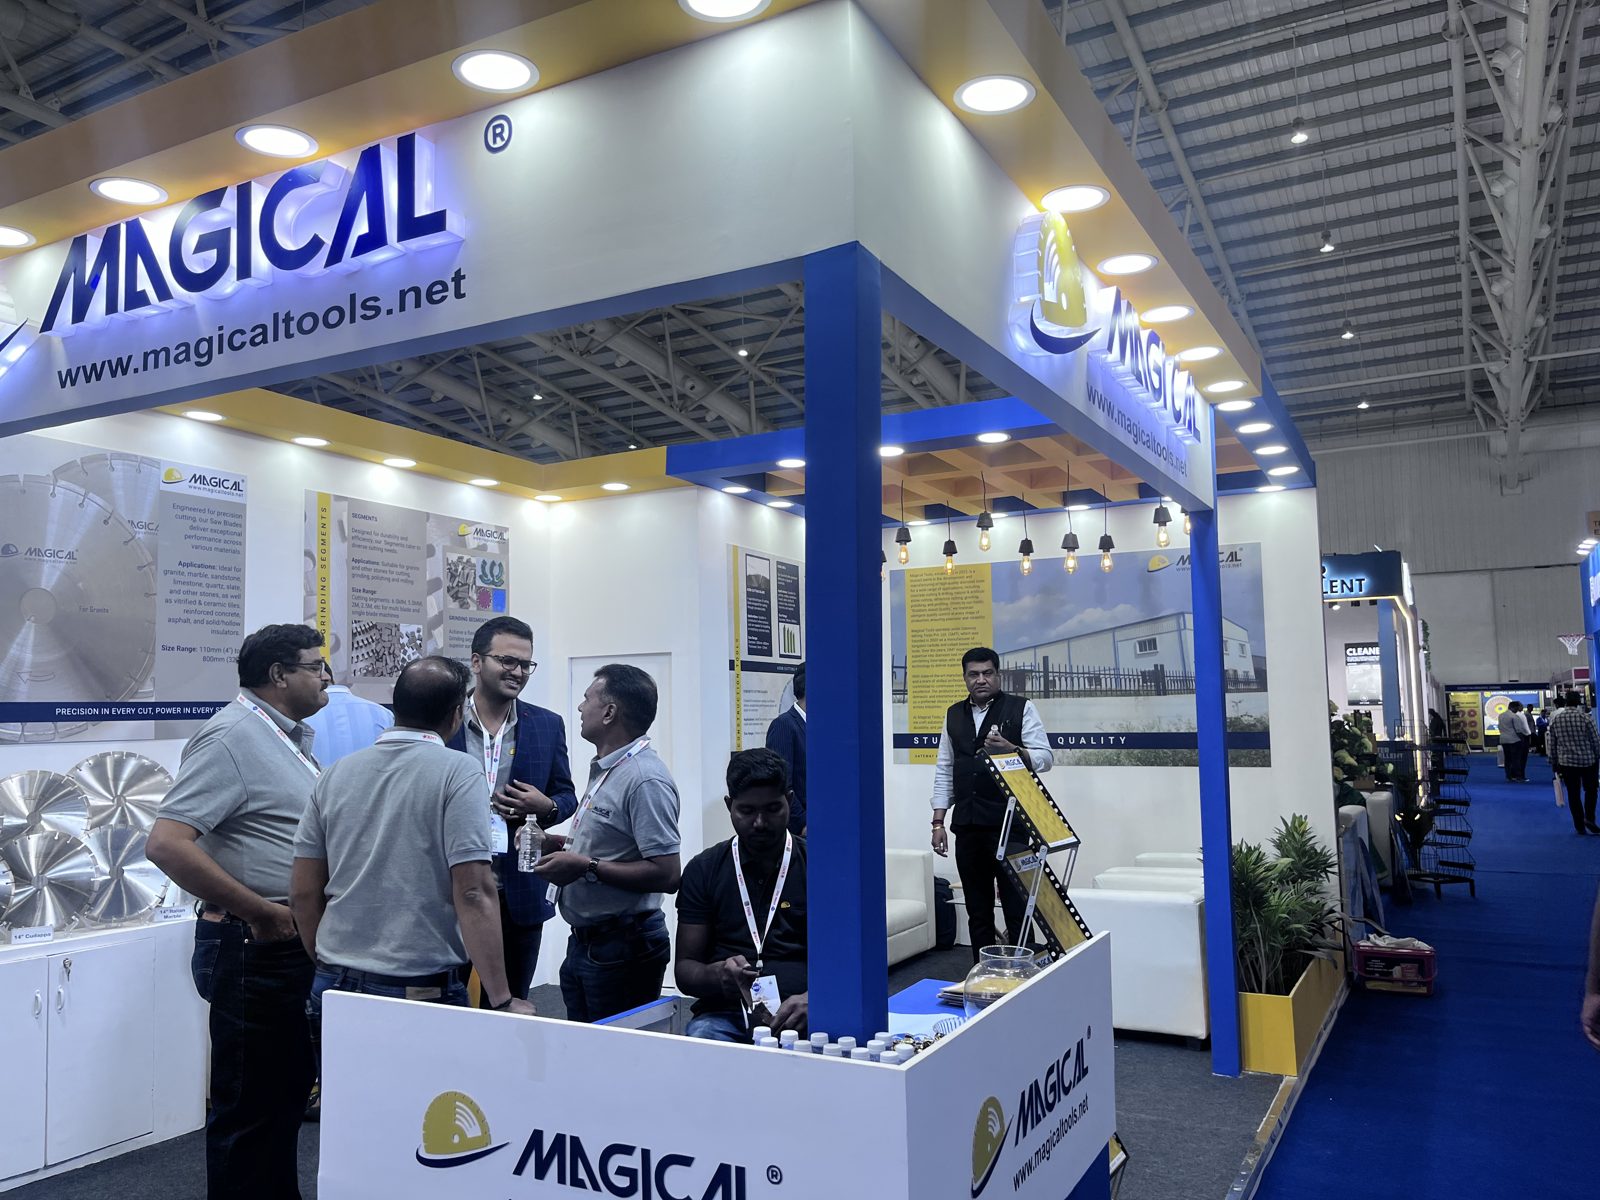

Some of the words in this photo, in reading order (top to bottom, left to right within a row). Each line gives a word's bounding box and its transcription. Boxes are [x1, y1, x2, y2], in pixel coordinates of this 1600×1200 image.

[39, 132, 447, 333] MAGICAL
[57, 267, 467, 389] www.magicaltools.net
[1105, 286, 1200, 443] MAGICAL
[1087, 381, 1188, 478] www.magicaltools.net
[188, 473, 244, 492] MAGICAL
[172, 503, 206, 514] Engineered
[216, 510, 242, 520] precision
[352, 513, 378, 522] SEGMENTS
[224, 520, 242, 528] Blades
[210, 528, 242, 537] exceptional
[473, 528, 506, 540] MAGICAL
[184, 534, 222, 544] performance
[24, 546, 77, 561] MAGICAL
[178, 560, 217, 570] Applications:
[1323, 578, 1365, 594] ENT
[184, 608, 213, 616] reinforced
[176, 646, 198, 654] Range:
[1346, 647, 1380, 656] CLEANE
[56, 707, 99, 716] PRECISION
[101, 707, 110, 715] IN
[112, 707, 135, 715] EVERY
[137, 707, 154, 715] CUT,
[1057, 736, 1127, 745] QUALITY
[1014, 1038, 1089, 1148] MAGICAL
[1013, 1092, 1089, 1192] www.magicaltools.net
